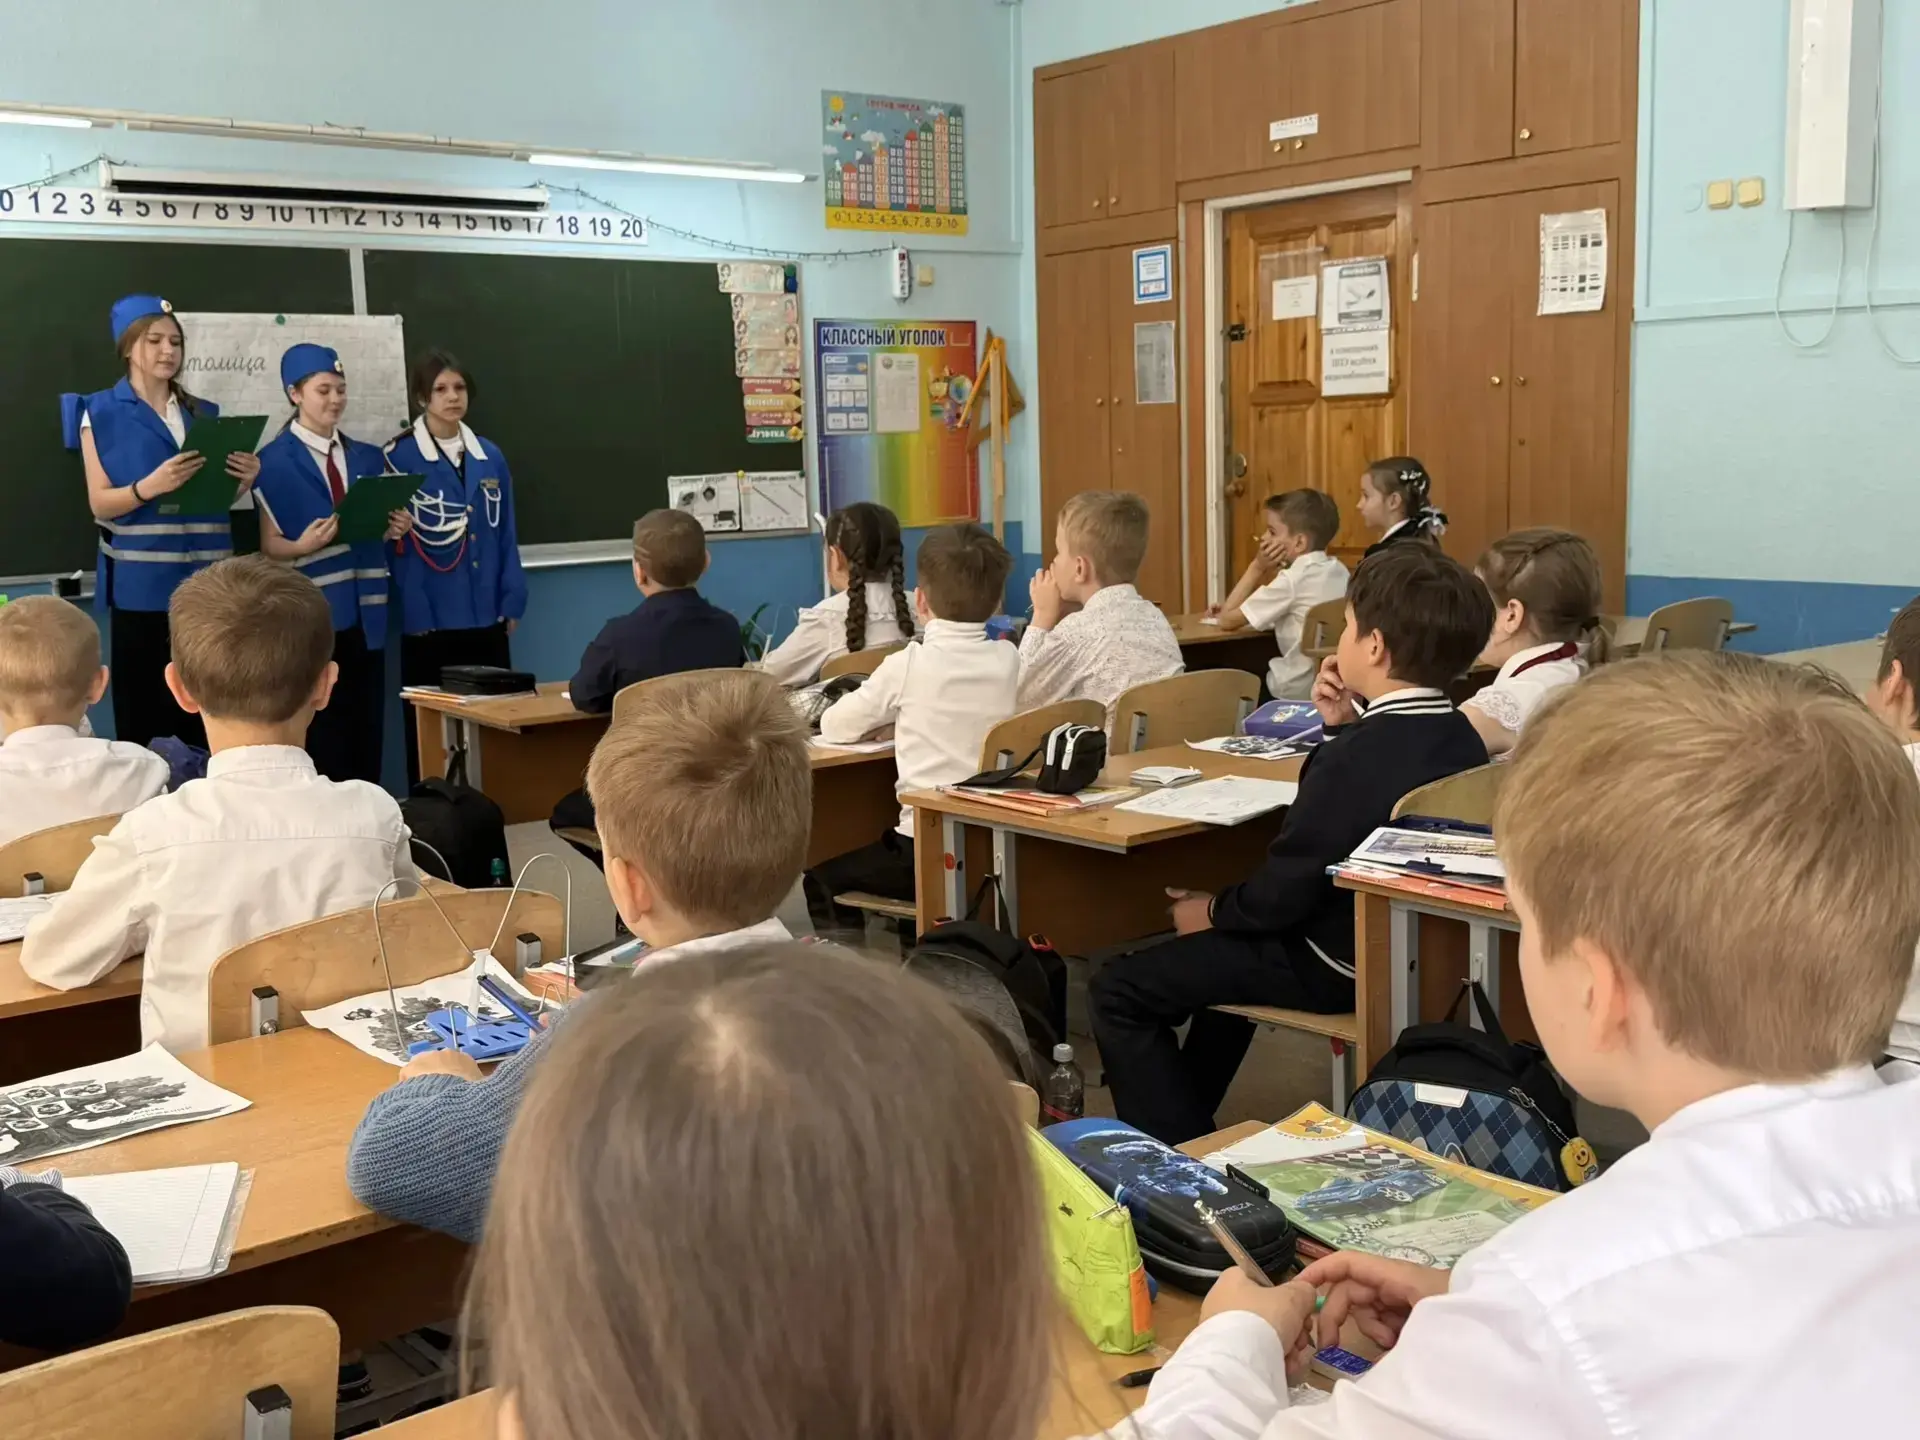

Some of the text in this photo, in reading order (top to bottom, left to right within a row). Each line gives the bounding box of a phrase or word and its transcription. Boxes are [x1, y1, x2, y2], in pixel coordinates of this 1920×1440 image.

[0, 189, 14, 212] 0
[28, 190, 40, 213] 1
[52, 192, 67, 214] 2
[80, 192, 95, 215] 3
[107, 199, 123, 216] 4
[136, 200, 150, 217] 5
[162, 201, 177, 218] 6
[214, 203, 229, 220] 8
[240, 204, 254, 221] 9
[266, 205, 293, 222] 10
[305, 206, 329, 224] 11
[340, 208, 367, 226] 12
[377, 210, 404, 227] 13
[414, 212, 441, 229] 14
[452, 213, 477, 230] 15
[488, 215, 512, 232] 16
[556, 215, 579, 235] 18
[589, 217, 611, 237] 19
[620, 219, 643, 238] 20
[835, 212, 958, 229] 0 1 2 3 4 5 6 7 8 9 10
[822, 325, 946, 345] КЛАССНЫЙ УГОЛОК
[184, 356, 266, 376] толица
